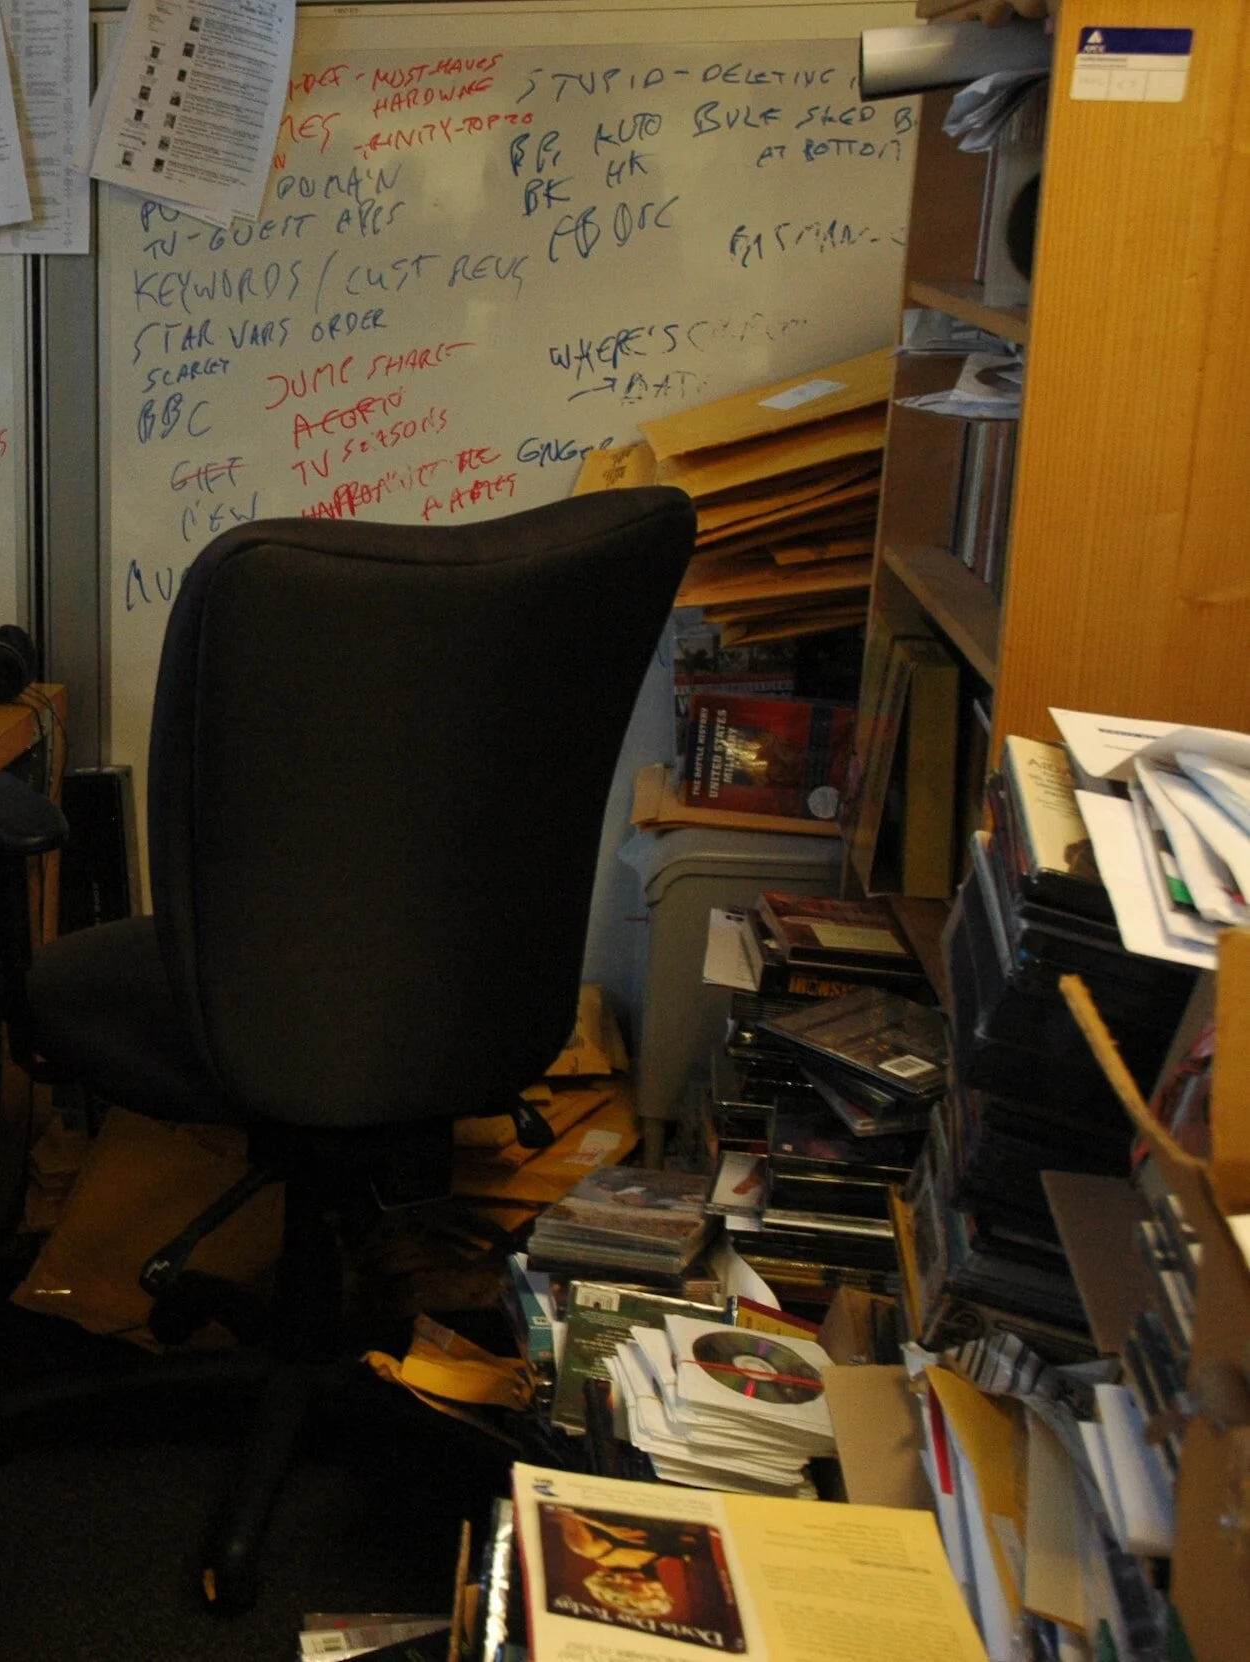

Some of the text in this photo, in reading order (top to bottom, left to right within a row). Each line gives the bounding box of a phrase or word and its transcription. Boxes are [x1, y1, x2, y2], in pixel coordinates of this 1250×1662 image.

[133, 260, 301, 314] KEYWORDS
[133, 318, 215, 366] STAR
[311, 308, 388, 342] ORDER
[708, 708, 728, 798] UNITED STATES
[661, 1620, 725, 1648] Doris
